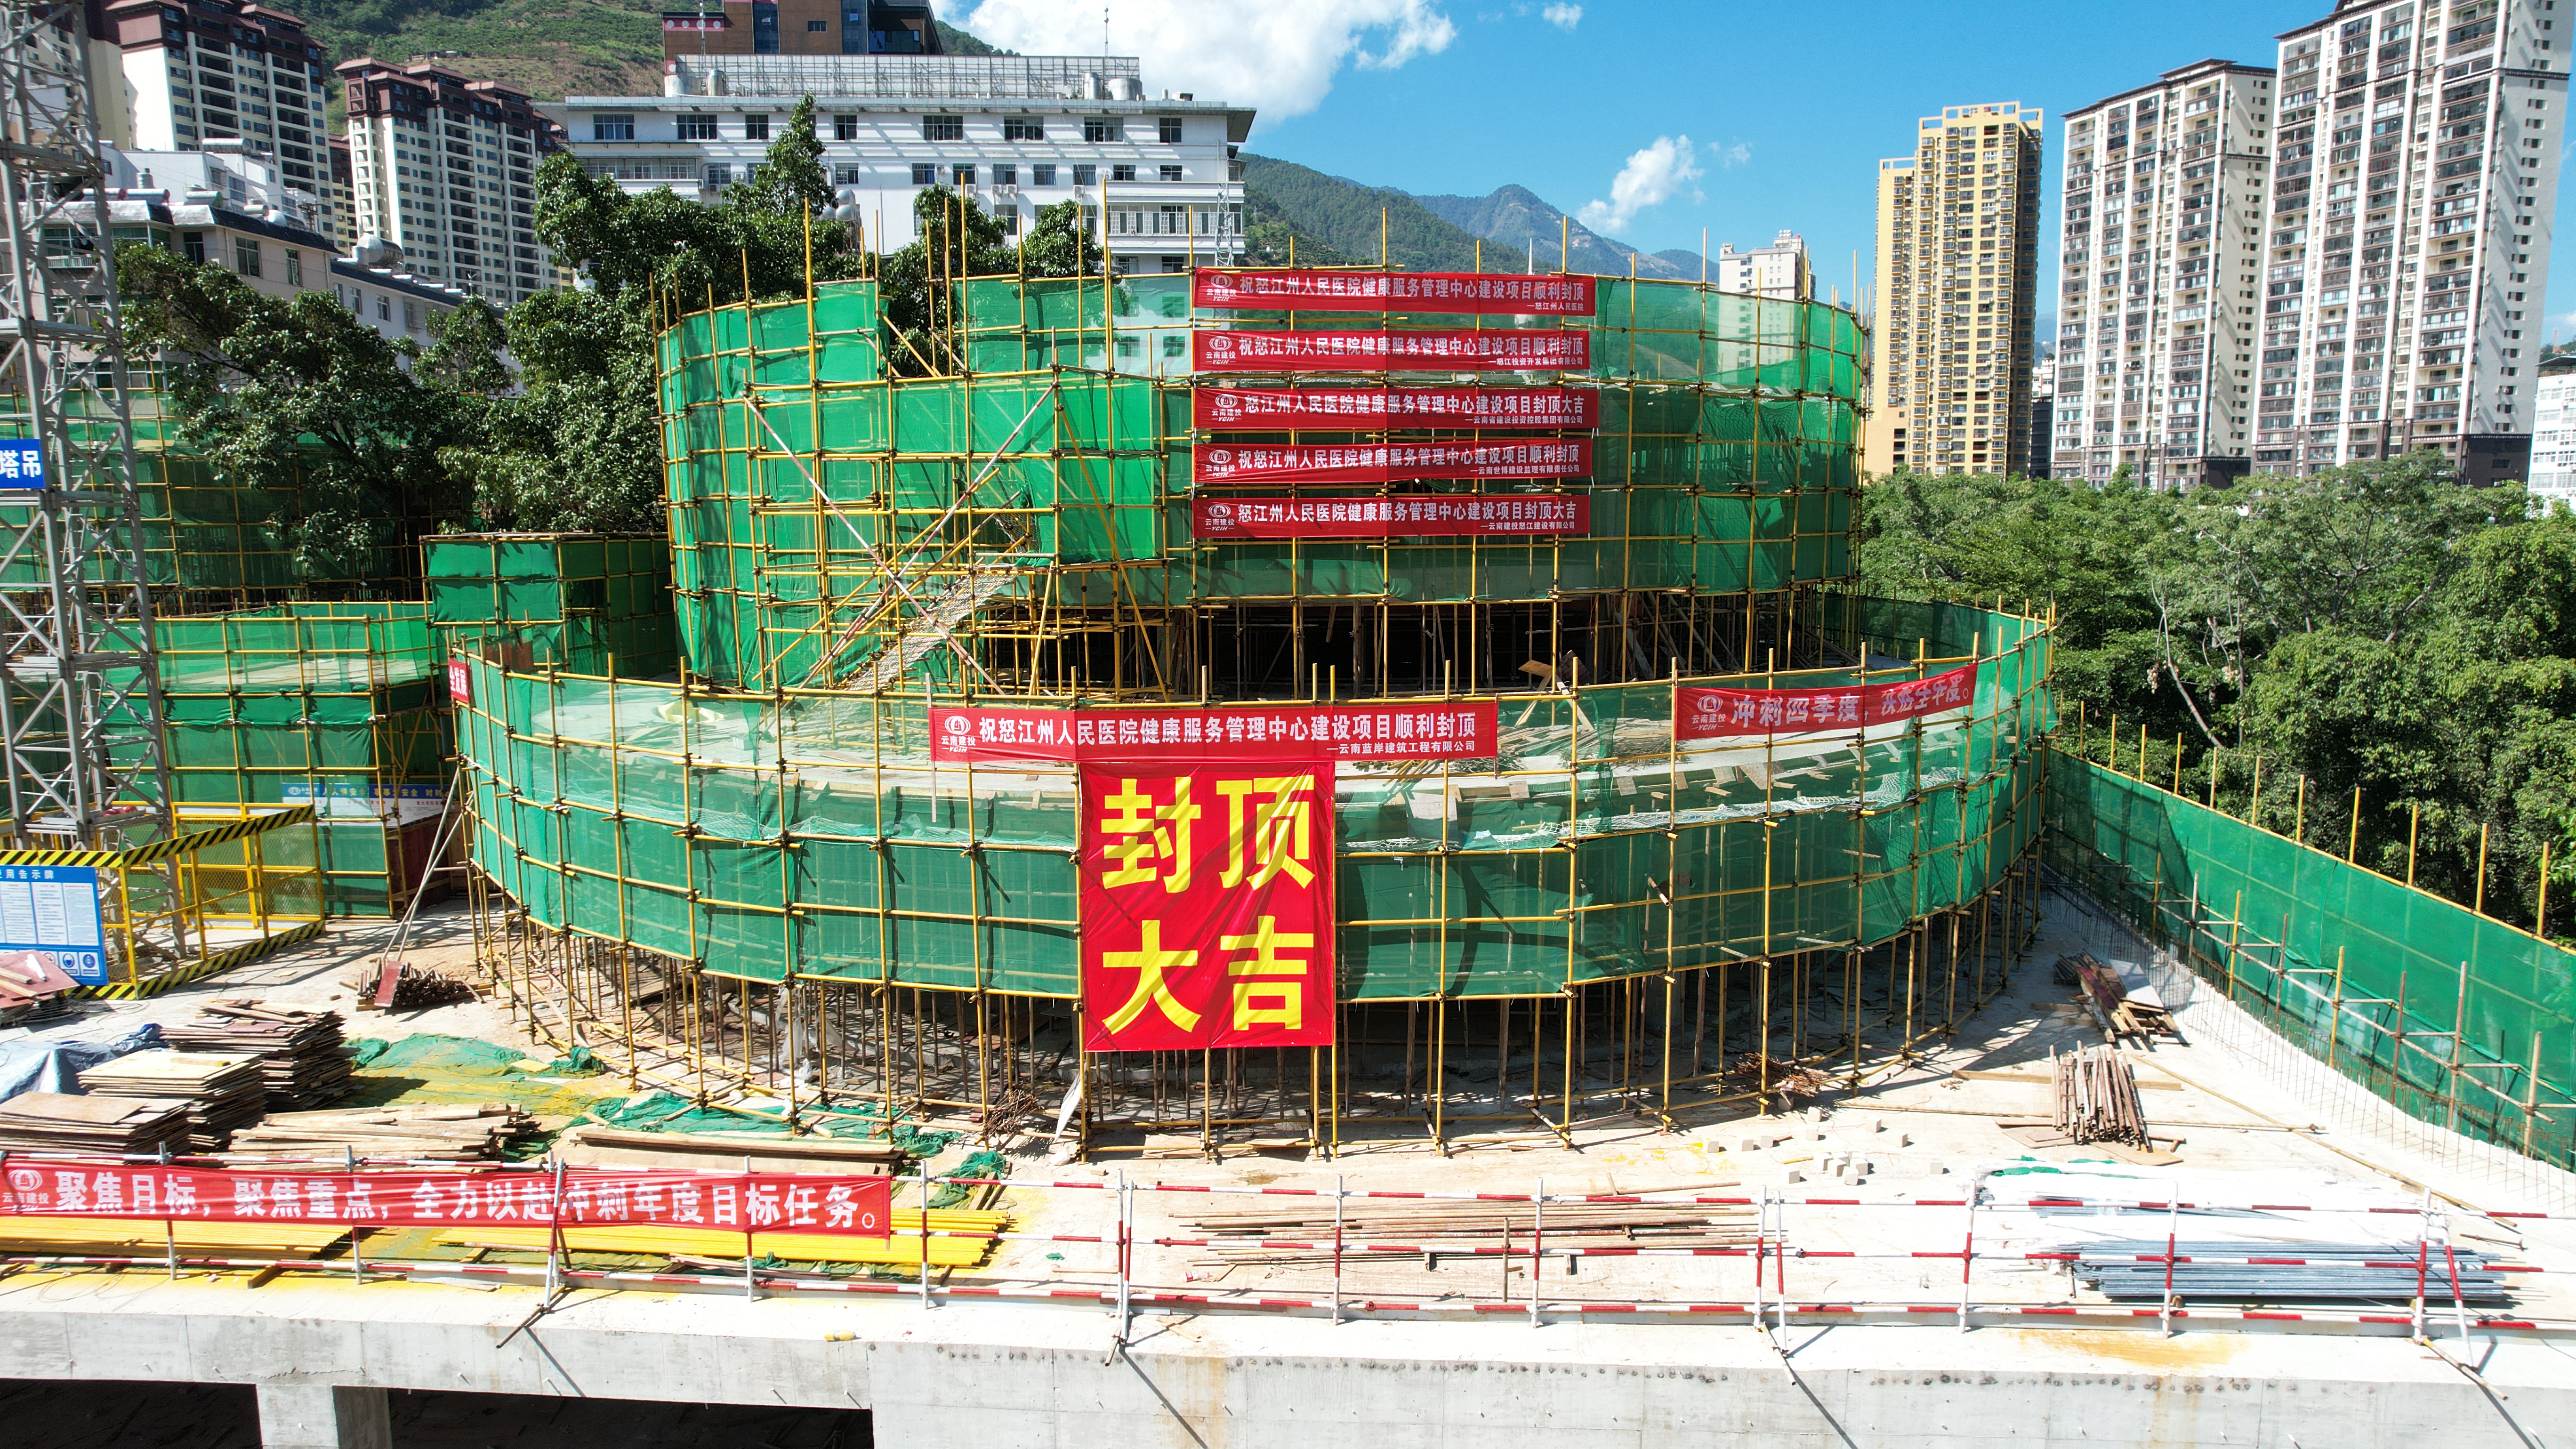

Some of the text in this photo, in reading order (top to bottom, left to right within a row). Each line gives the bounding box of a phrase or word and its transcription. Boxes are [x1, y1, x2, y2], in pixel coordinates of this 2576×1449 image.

[1240, 276, 1584, 301] 祝怒江州人民医院健康服务管理中心建设项目顺利封顶
[1239, 336, 1583, 356] 祝怒江州人民医院健康服务管理中心建设项目顺利封顶
[1211, 408, 1242, 416] 云南建投
[1244, 394, 1584, 414] 怒江州人民医院健康服务管理中心建设项目封顶大吉
[1238, 444, 1579, 469] 祝怒江州人民医院健康服务管理中心建设项目顺利封顶
[1205, 464, 1235, 472] 云南建投
[1238, 501, 1576, 522] 怒江州人民医院健康服务管理中心建设项目封顶大吉
[1205, 518, 1235, 526] 云南建投
[1692, 713, 1727, 724] 云南建投
[979, 712, 1476, 746] 祝怒江州人民医院健康服务管理中心建设项目顺利封顶
[941, 735, 977, 746] 云南建投
[1101, 774, 1315, 894] 封顶
[0, 869, 54, 879] 用告示牌
[1102, 915, 1314, 1036] 大吉
[1, 1192, 49, 1204] 云南建投
